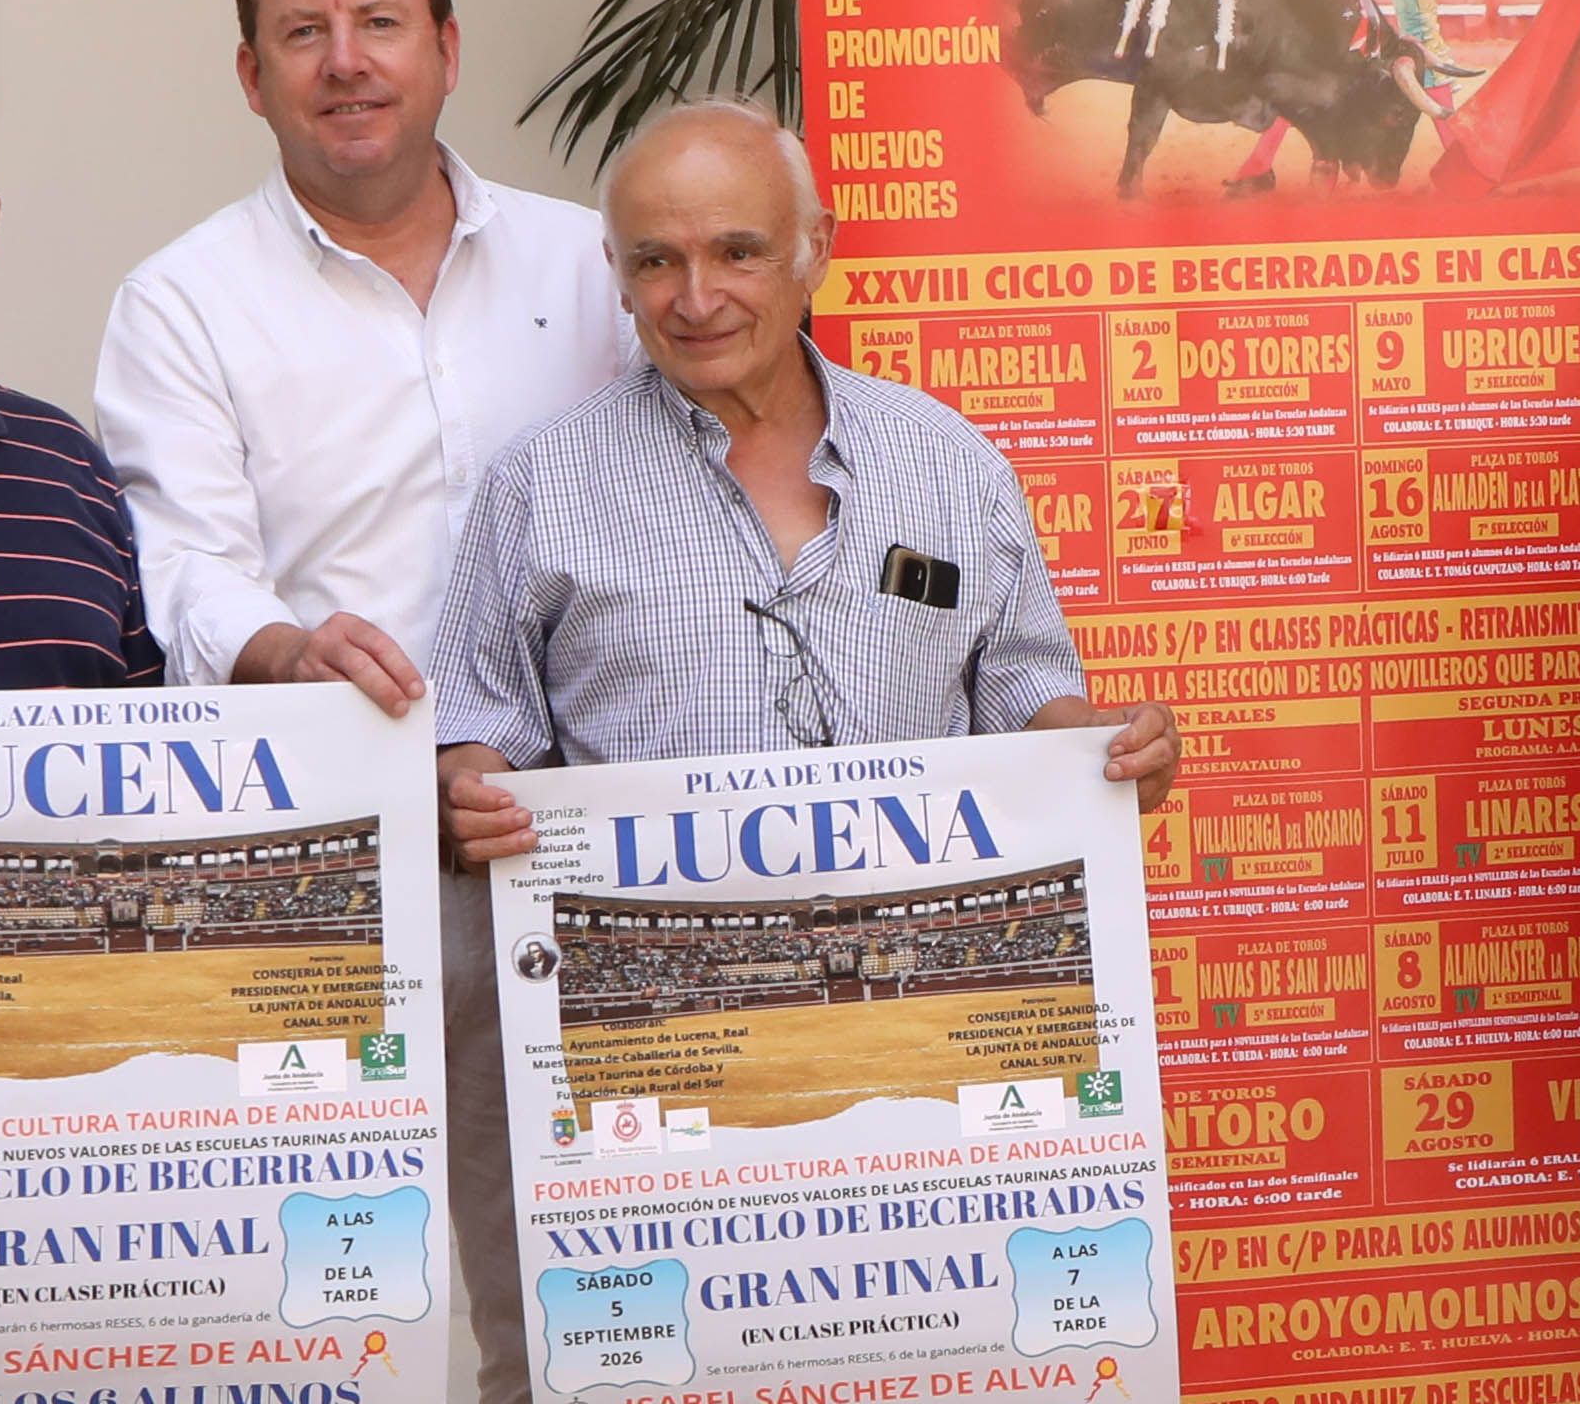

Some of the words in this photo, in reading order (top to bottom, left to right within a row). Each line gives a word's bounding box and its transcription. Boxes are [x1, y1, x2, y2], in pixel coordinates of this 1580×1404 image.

[827, 16, 1000, 68] PROMOCIÓN
[829, 81, 865, 119] DE
[831, 129, 943, 170] NUEVOS
[832, 180, 958, 221] VALORES
[844, 268, 968, 305] XXVIII
[985, 263, 1093, 300] CICLO
[1109, 261, 1156, 295] DE
[1172, 251, 1420, 293] BECERRADAS
[1436, 249, 1482, 283] EN
[930, 344, 1087, 388] MARBELLA
[1180, 338, 1236, 379] DOS
[1245, 334, 1350, 376] TORRES
[1443, 326, 1580, 368] UBRIQUE
[1213, 480, 1325, 522] ALGAR
[73, 704, 111, 725] DE
[119, 701, 220, 724] TOROS
[686, 768, 776, 794] PLAZA
[784, 764, 821, 787] DE
[828, 756, 924, 782] TOROS
[608, 787, 1004, 888] LUCENA
[2, 1114, 119, 1137] CULTURA
[126, 1108, 239, 1131] TAURINA
[247, 1105, 277, 1125] DE
[285, 1098, 428, 1123] ANDALUCIA
[1417, 1091, 1475, 1133] 29
[547, 1221, 673, 1258] XXVIII
[684, 1211, 805, 1247] CICLO
[817, 1204, 869, 1236] DE
[880, 1179, 1147, 1230] BECERRADAS
[119, 1218, 269, 1261] FINAL
[1052, 1243, 1062, 1259] A
[1069, 1243, 1098, 1258] LAS
[1178, 1237, 1227, 1281] S/P
[1237, 1235, 1268, 1269] EN
[1278, 1227, 1327, 1272] C/P
[1336, 1225, 1403, 1260] PARA
[1412, 1220, 1454, 1255] LOS
[1068, 1269, 1079, 1285] 7
[1054, 1297, 1074, 1311] DE
[1080, 1295, 1100, 1309] LA
[1053, 1316, 1106, 1332] TARDE
[931, 1371, 973, 1396] DE
[985, 1364, 1076, 1392] ALVA
